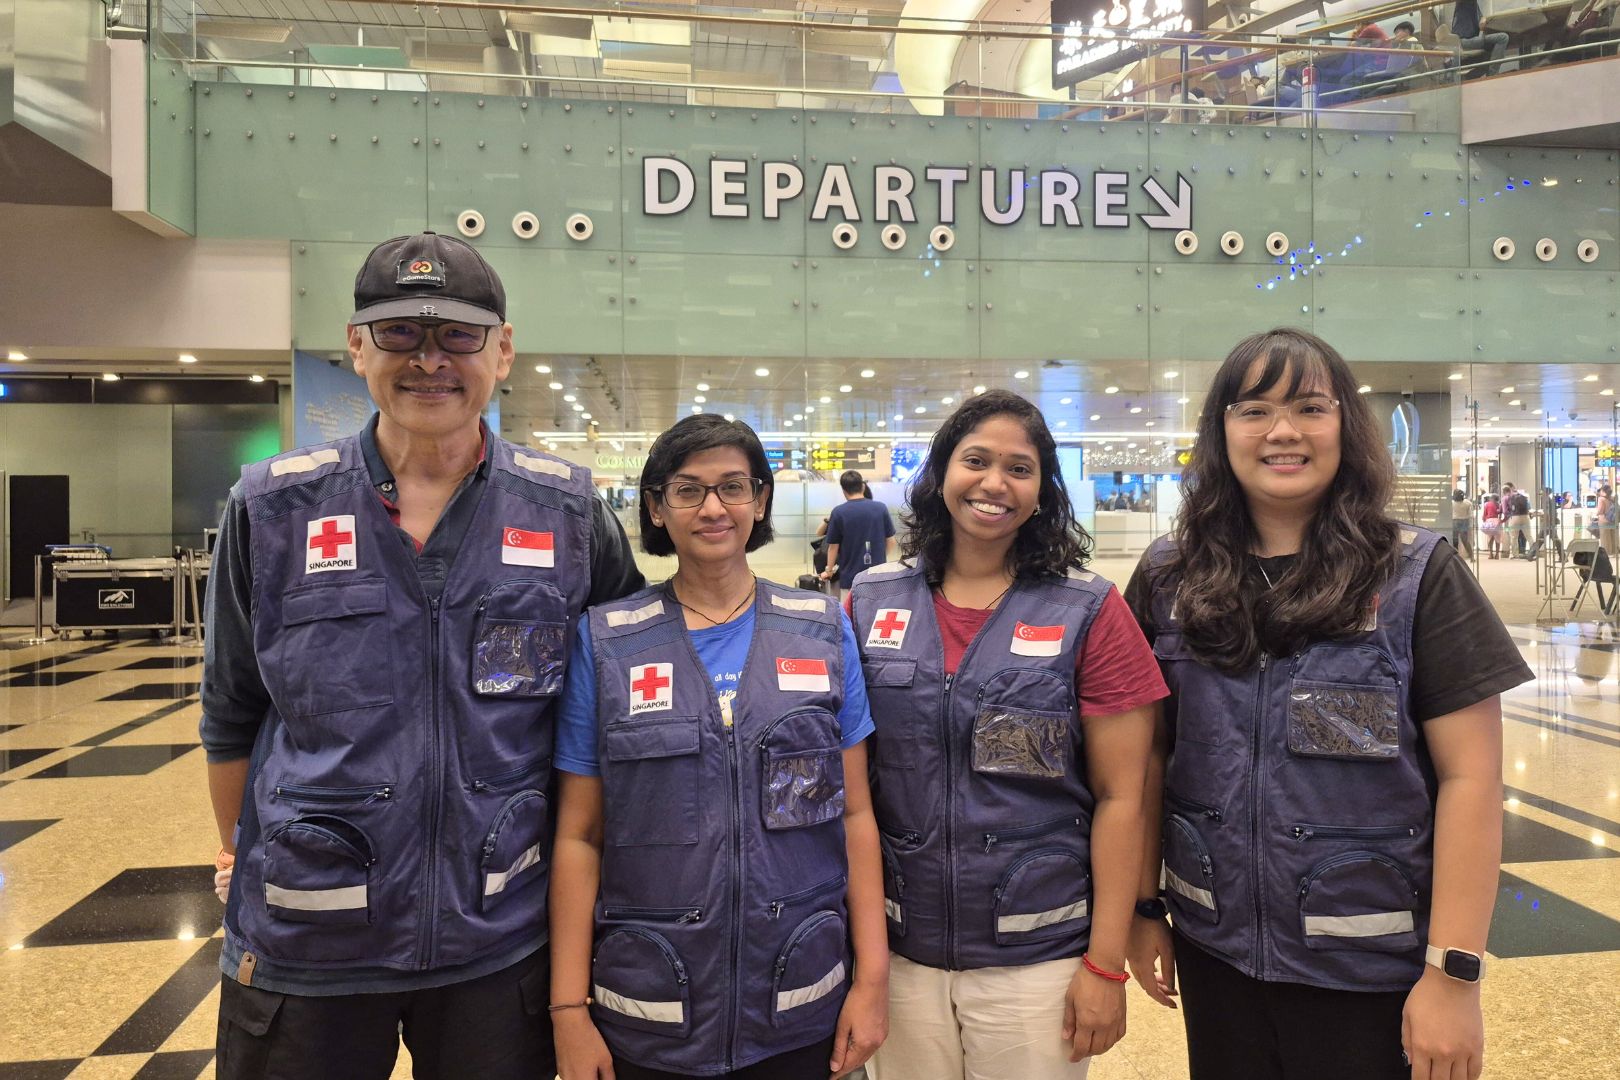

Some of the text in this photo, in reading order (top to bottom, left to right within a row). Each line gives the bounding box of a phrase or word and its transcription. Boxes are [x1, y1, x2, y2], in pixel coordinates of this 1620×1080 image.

[642, 156, 1130, 228] DEPARTURE
[308, 560, 354, 571] SINGAPORE
[868, 639, 900, 647] SINGAPORE
[725, 672, 736, 681] day
[631, 700, 669, 712] SINGAPORE
